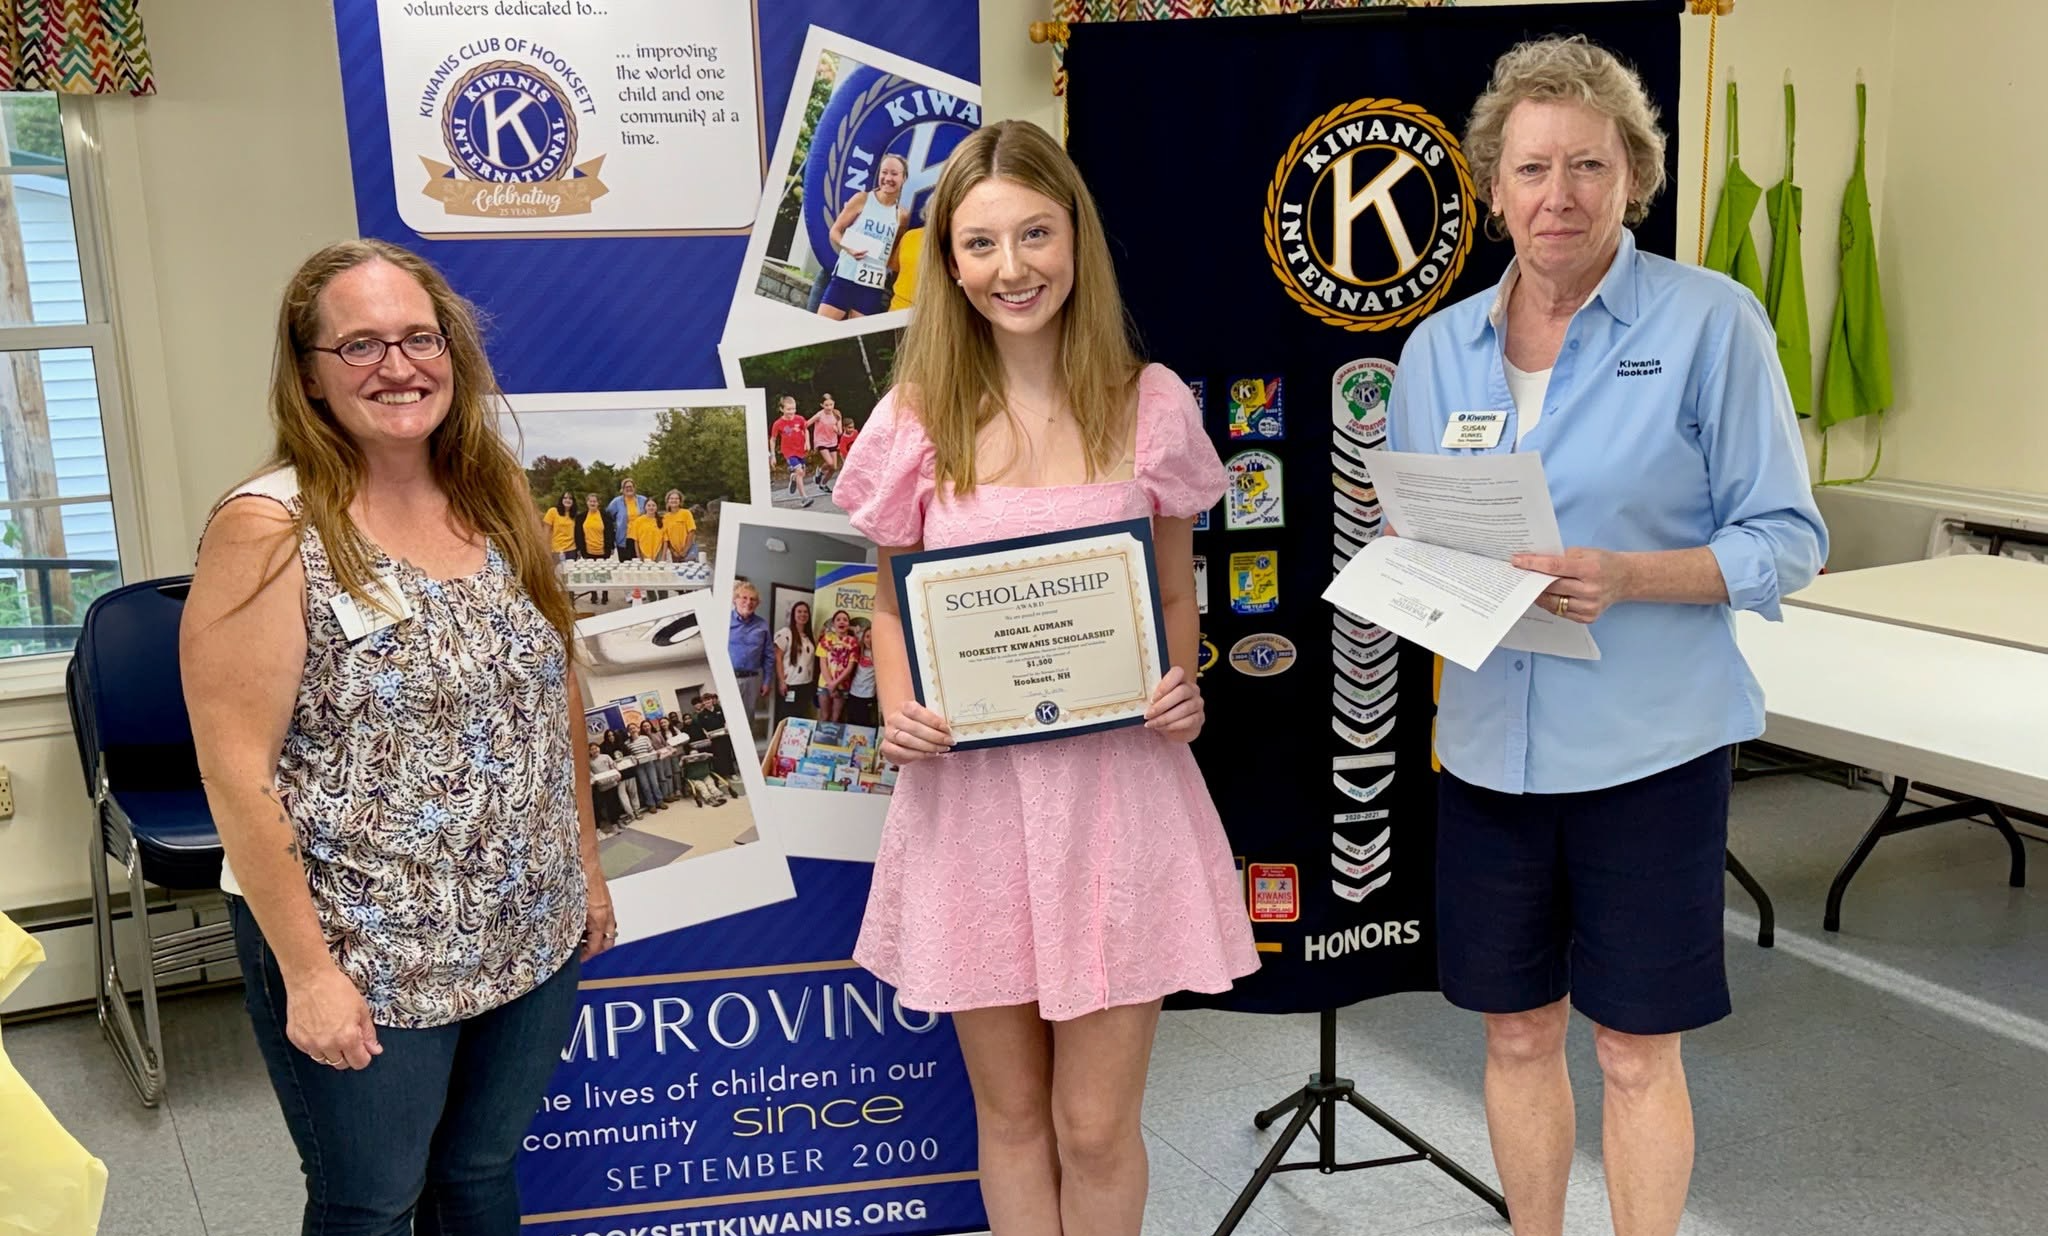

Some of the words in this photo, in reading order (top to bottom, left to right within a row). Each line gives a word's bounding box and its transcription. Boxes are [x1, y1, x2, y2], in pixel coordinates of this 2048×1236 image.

[404, 1, 488, 16] volunteers
[494, 0, 571, 16] dedicated
[576, 1, 608, 15] to...
[636, 43, 718, 62] improving
[419, 54, 460, 118] KIWANIS
[459, 38, 500, 60] CLUB
[504, 37, 527, 53] OF
[530, 43, 597, 116] HOOKSETT
[616, 65, 640, 80] the
[645, 64, 691, 80] world
[696, 68, 725, 79] one
[463, 73, 551, 103] KIWANIS
[618, 86, 656, 101] child
[661, 86, 691, 101] and
[696, 90, 725, 101] one
[884, 89, 981, 127] KIWA
[620, 109, 706, 127] community
[712, 109, 725, 122] at
[730, 111, 740, 122] a
[482, 91, 543, 166] K
[621, 131, 659, 145] time.
[454, 117, 566, 183] INTERNATIONAL
[1303, 119, 1445, 173] KIWANIS
[472, 184, 561, 213] Celebrating
[509, 208, 537, 216] YEARS
[1330, 151, 1420, 282] K
[864, 219, 896, 238] RUN
[1281, 193, 1461, 312] INTERNATIONAL
[858, 269, 884, 286] 217
[1616, 366, 1663, 377] Hooksett
[1619, 358, 1662, 369] Kiwanis
[1467, 414, 1497, 422] Kiwanis
[945, 571, 1110, 611] SCHOLARSHIP
[1016, 601, 1045, 610] AWARD
[994, 627, 1031, 638] ABIGAIL
[1033, 620, 1074, 633] AUMANN
[959, 645, 1008, 659] HOOKSETT
[1010, 639, 1050, 652] KIWANIS
[1052, 629, 1115, 646] SCHOLARSHIP
[1026, 658, 1053, 668] $1,500
[1014, 674, 1055, 686] Hooksett,
[1057, 672, 1071, 681] NH
[1257, 892, 1292, 900] KIWANIS
[1304, 919, 1421, 961] HONORS
[585, 1081, 655, 1109] lives
[667, 1072, 698, 1100] of
[711, 1064, 837, 1097] children
[850, 1063, 876, 1084] in
[888, 1061, 936, 1081] our
[522, 1116, 698, 1152] community
[733, 1095, 904, 1137] since
[606, 1148, 824, 1192] SEPTEMBER
[852, 1137, 939, 1168] 2000
